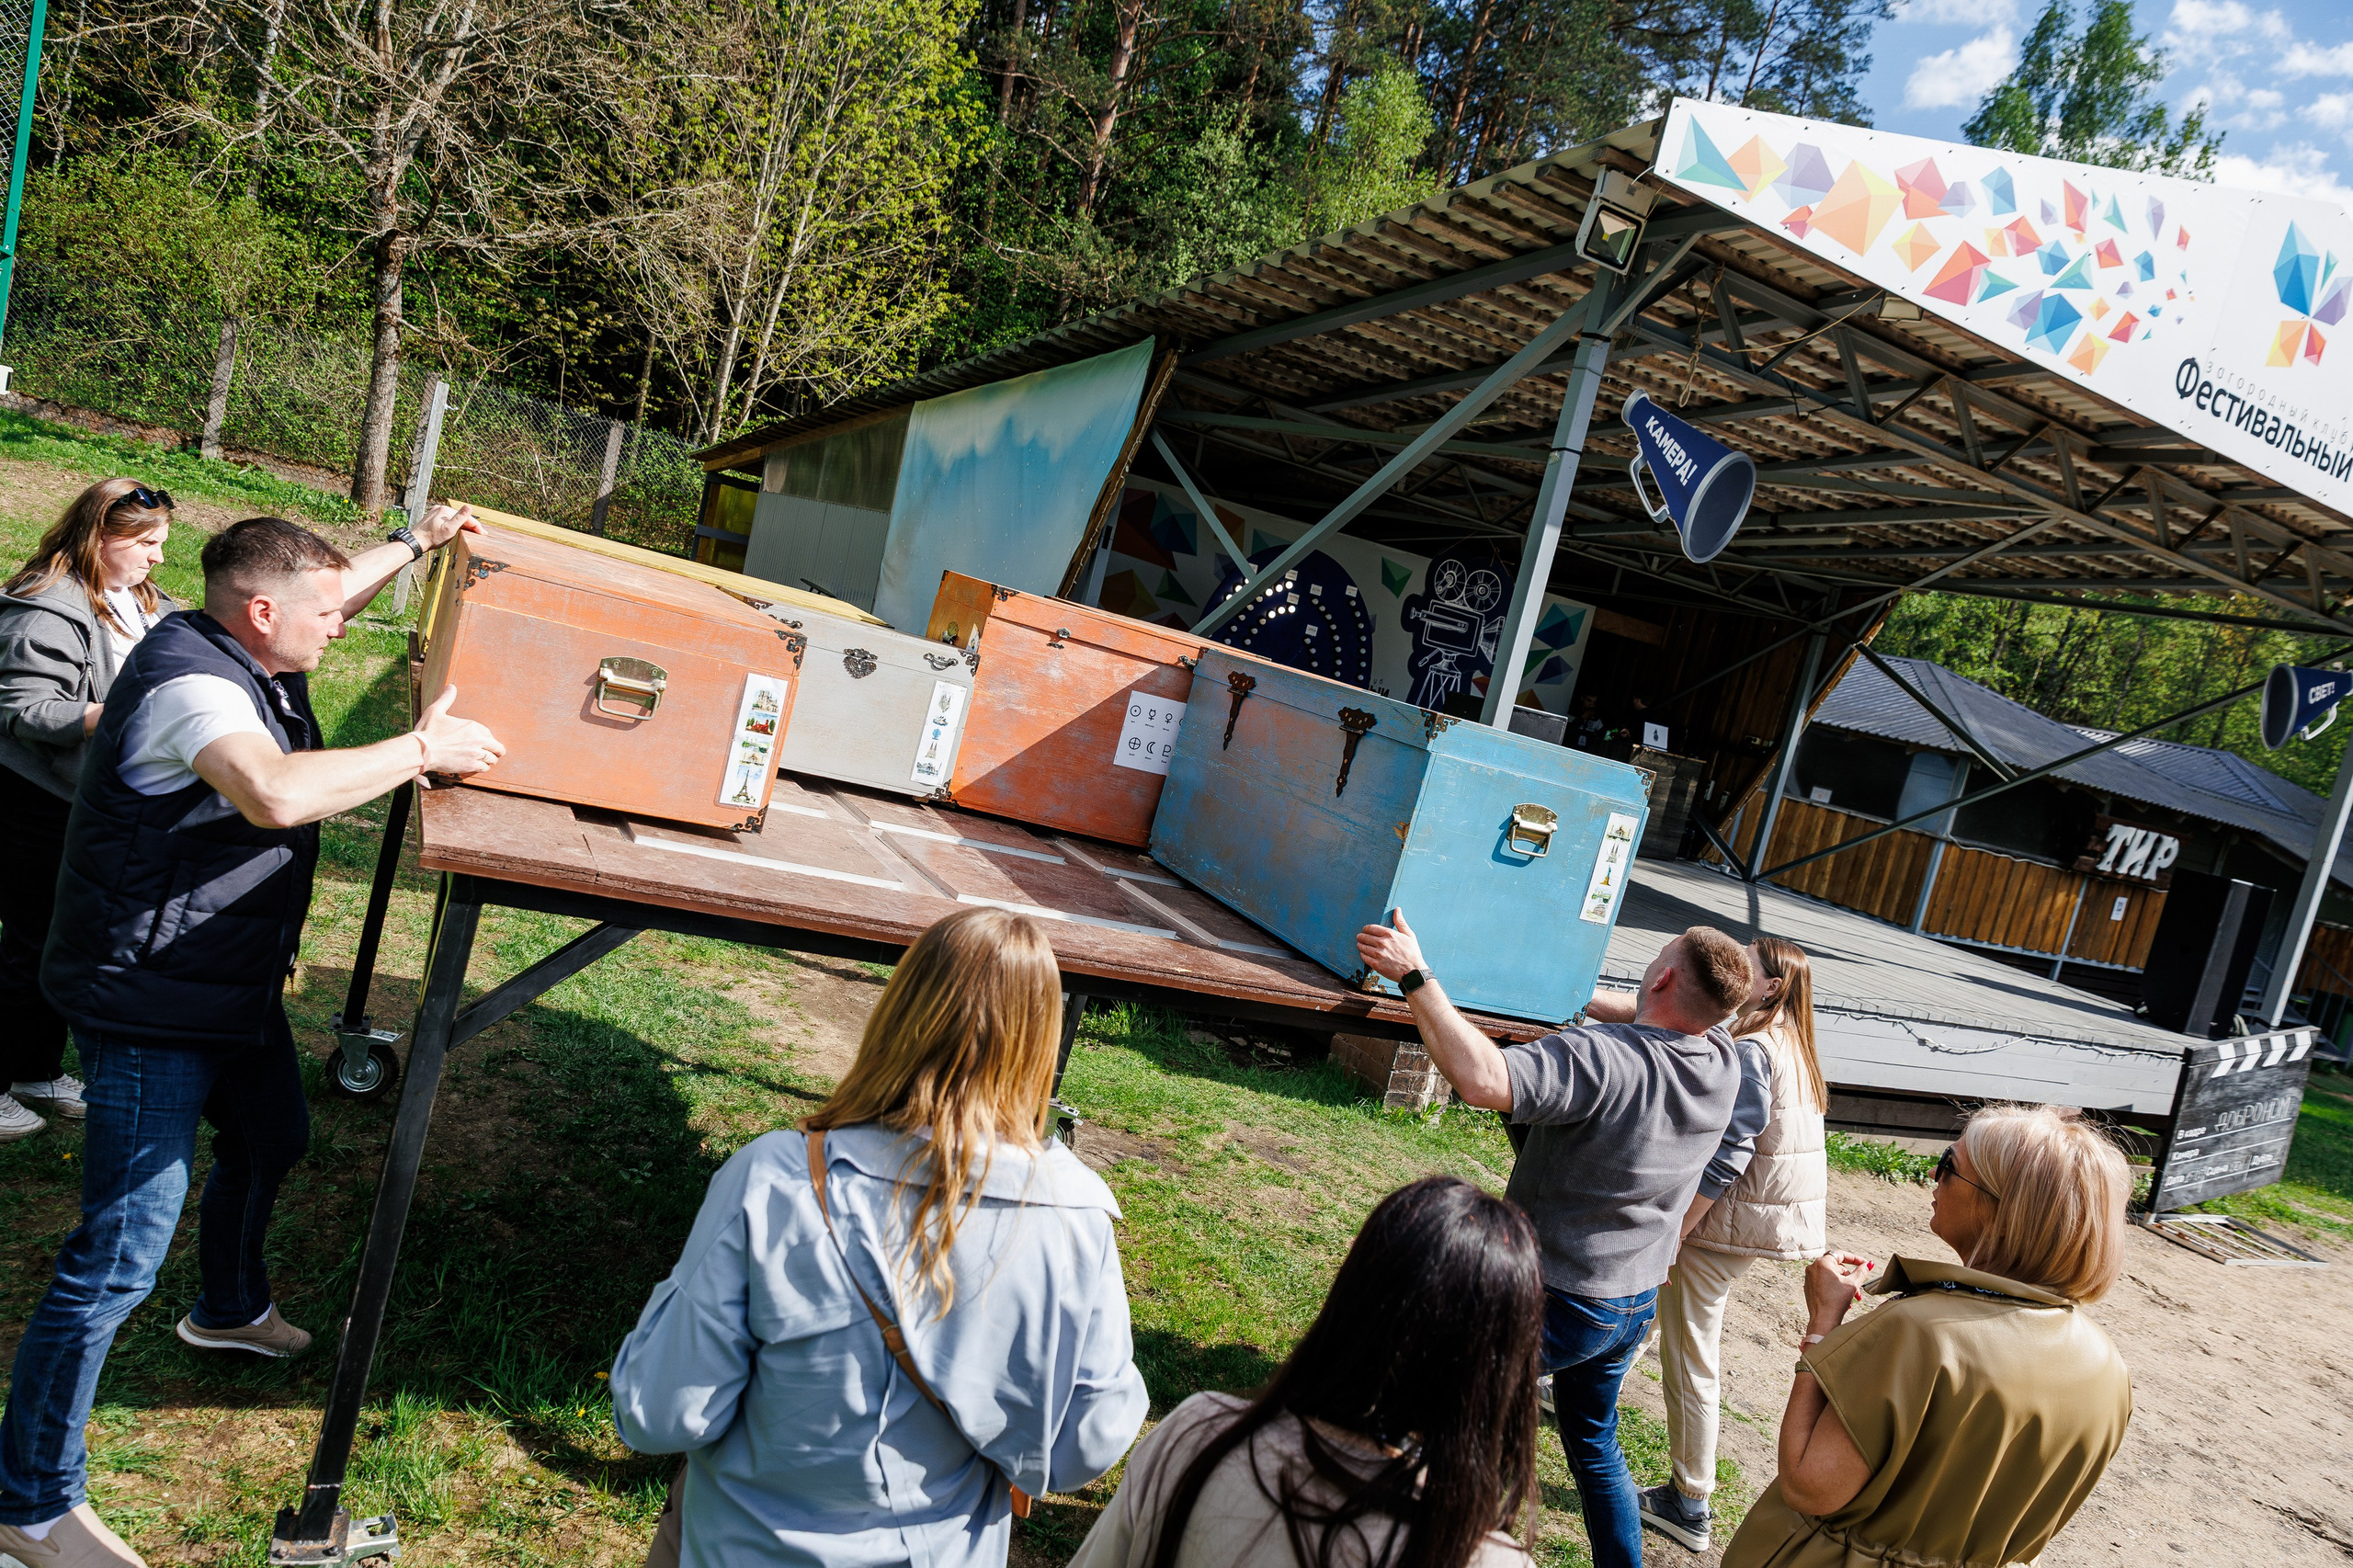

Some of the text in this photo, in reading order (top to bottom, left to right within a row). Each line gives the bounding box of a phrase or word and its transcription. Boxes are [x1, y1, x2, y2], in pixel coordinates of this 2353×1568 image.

[2176, 357, 2353, 483] Фестивальный
[2313, 418, 2349, 445] клуб
[1645, 415, 1698, 486] КАМЕРА!
[2308, 681, 2336, 705] СВЕТ!
[2096, 824, 2180, 881] ТИР
[2177, 1127, 2207, 1140] В кадре
